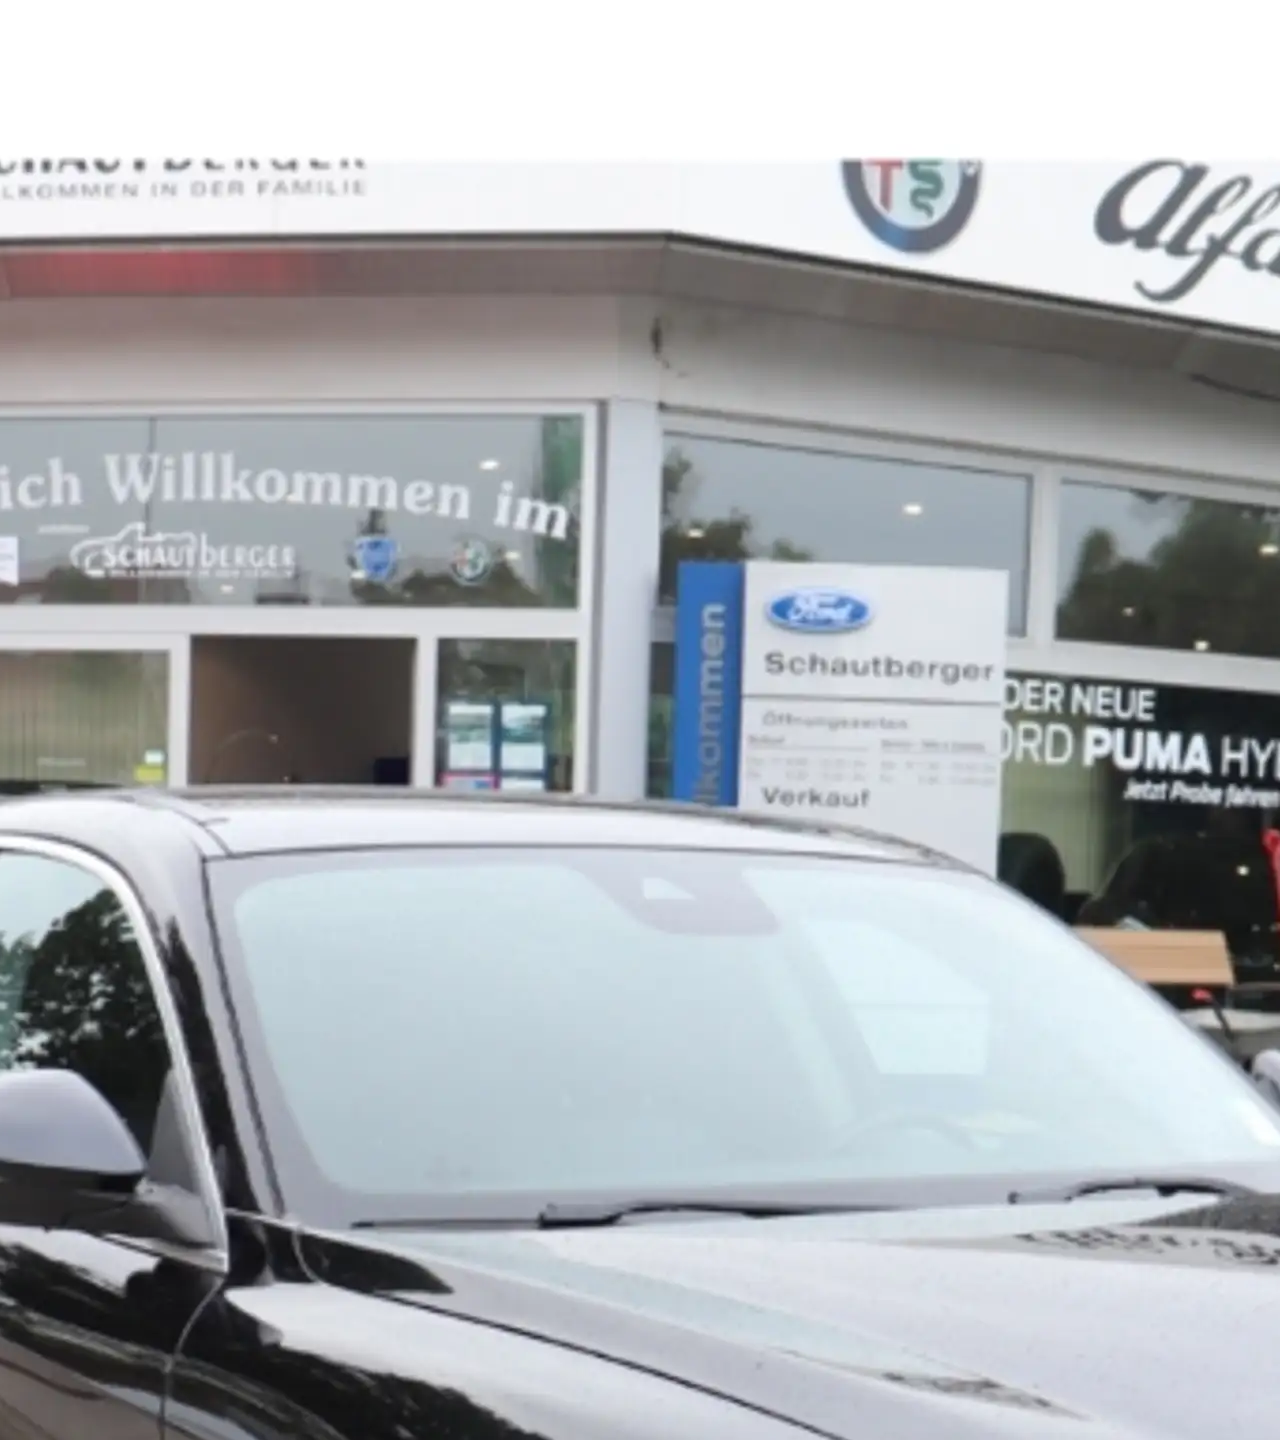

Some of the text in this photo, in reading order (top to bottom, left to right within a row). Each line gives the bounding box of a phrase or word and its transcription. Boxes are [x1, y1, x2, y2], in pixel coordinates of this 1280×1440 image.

[150, 182, 178, 198] IN
[103, 450, 469, 519] Willkommen
[493, 479, 568, 541] im
[764, 650, 995, 686] Schautberger
[1002, 679, 1155, 722] DER NEUE
[1082, 724, 1214, 775] PUMA
[761, 786, 872, 808] Verkauf
